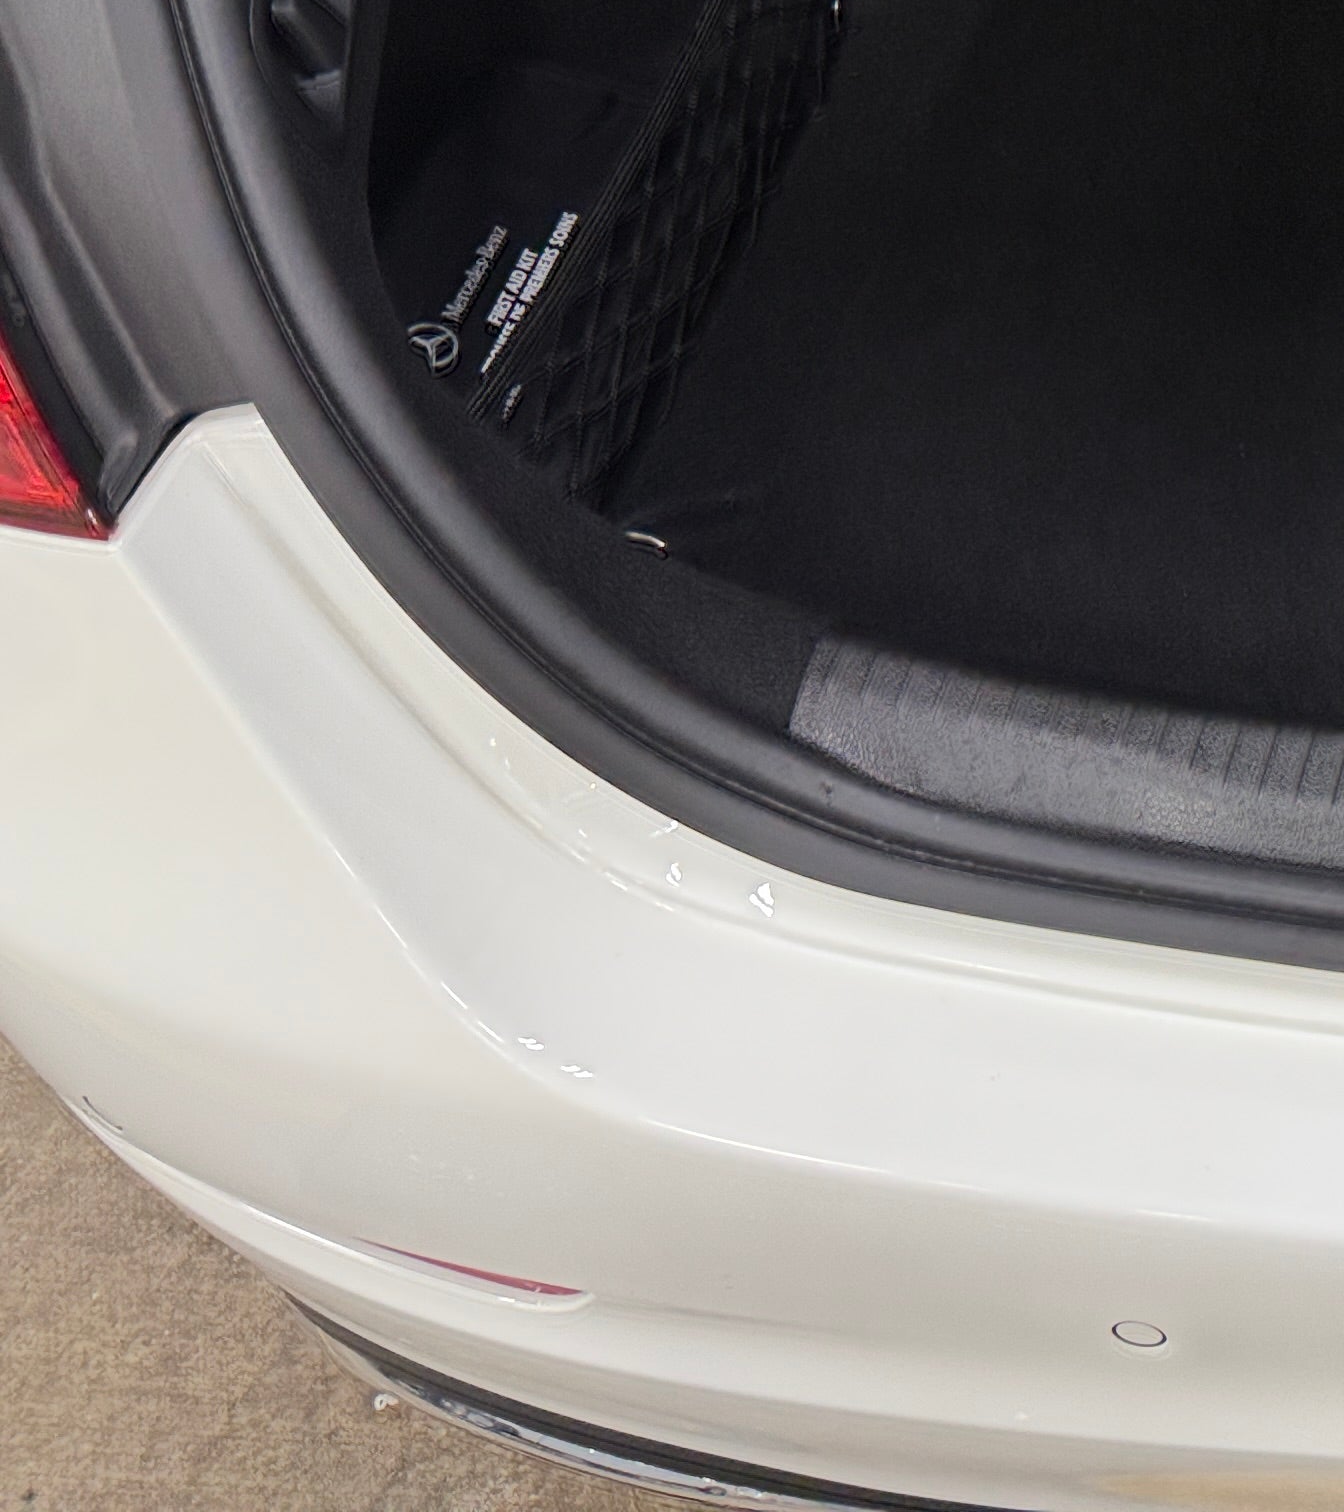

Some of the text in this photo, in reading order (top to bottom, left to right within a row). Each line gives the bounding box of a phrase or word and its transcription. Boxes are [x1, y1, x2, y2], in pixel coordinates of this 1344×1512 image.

[487, 247, 539, 326] FIRST AID KIT
